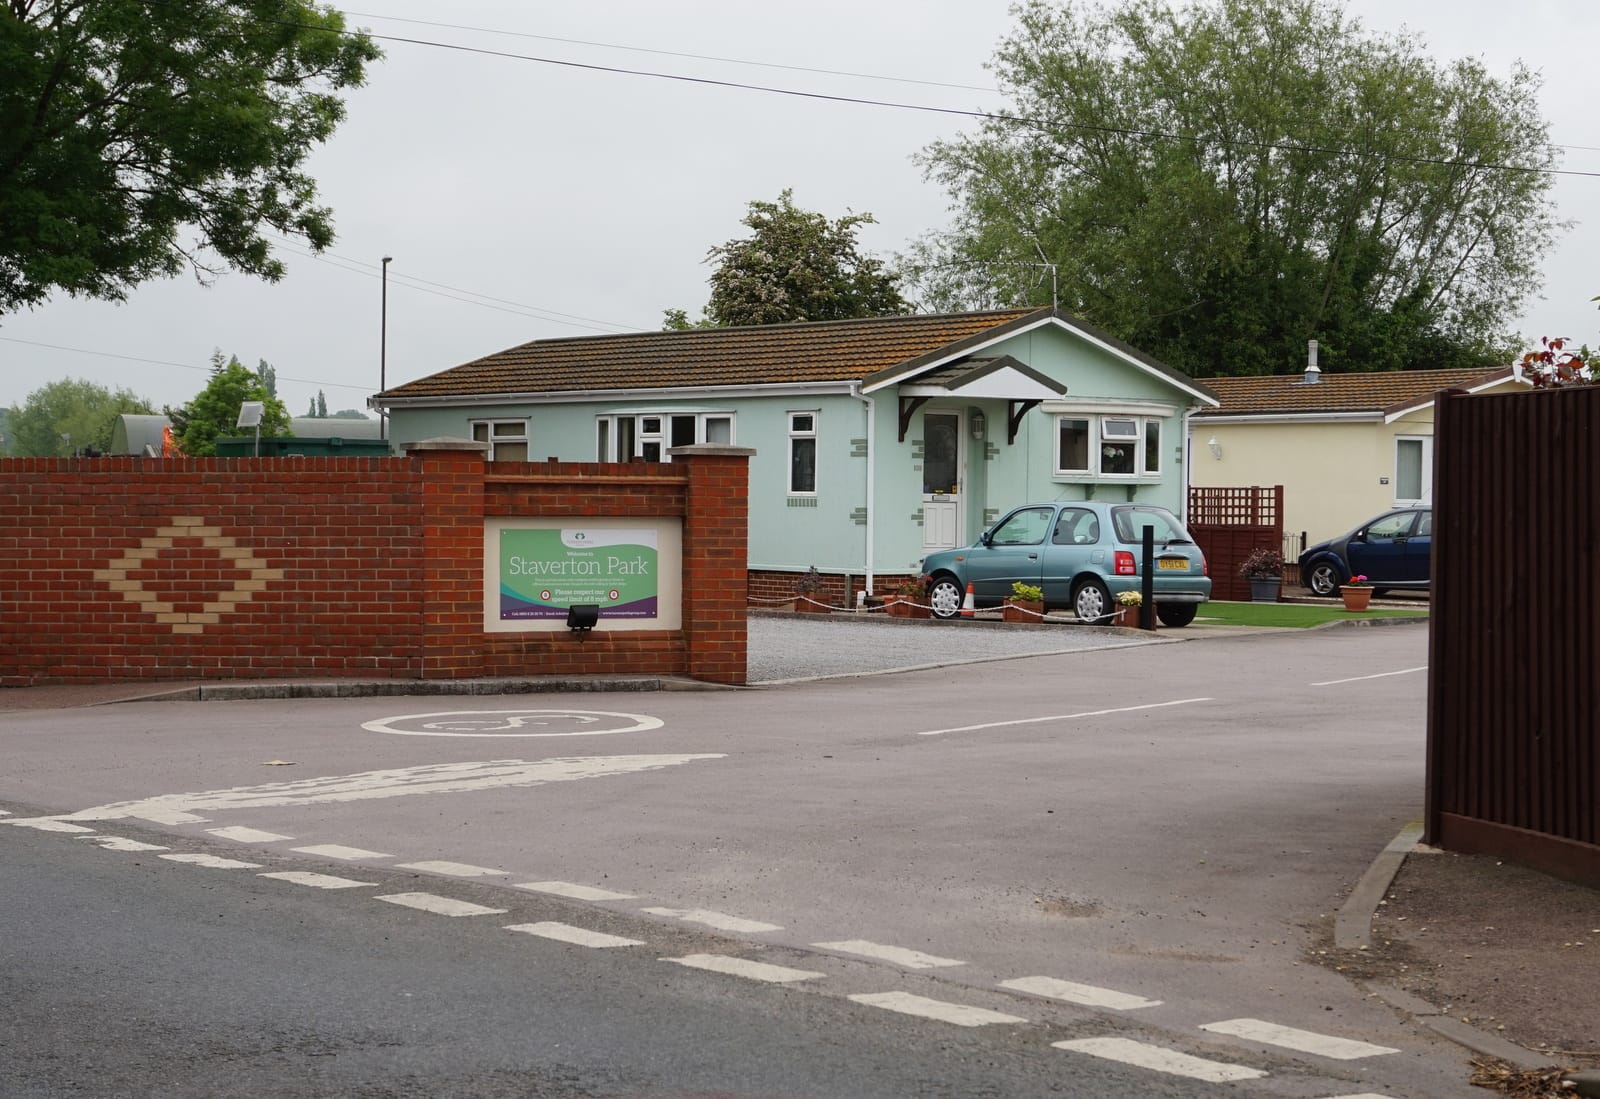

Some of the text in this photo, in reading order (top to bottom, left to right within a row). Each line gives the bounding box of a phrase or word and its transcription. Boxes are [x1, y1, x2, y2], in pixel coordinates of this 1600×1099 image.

[509, 556, 648, 575] Staverton Park
[573, 589, 594, 597] respect
